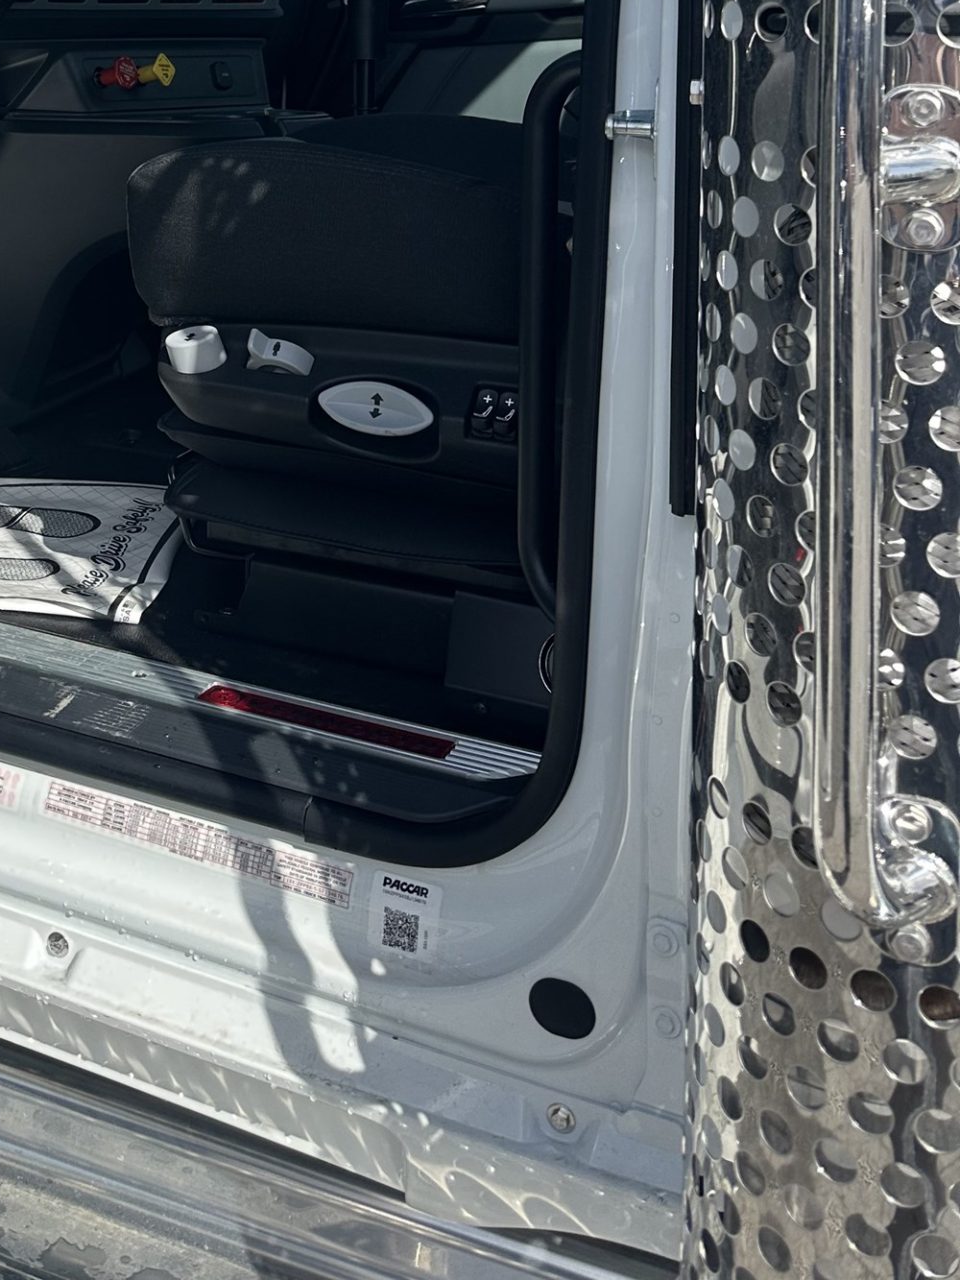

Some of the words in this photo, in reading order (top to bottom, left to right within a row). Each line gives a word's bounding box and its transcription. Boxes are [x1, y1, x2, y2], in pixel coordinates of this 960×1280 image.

[61, 569, 107, 597] Please
[91, 535, 127, 572] Drive
[382, 875, 429, 898] PACCAR
